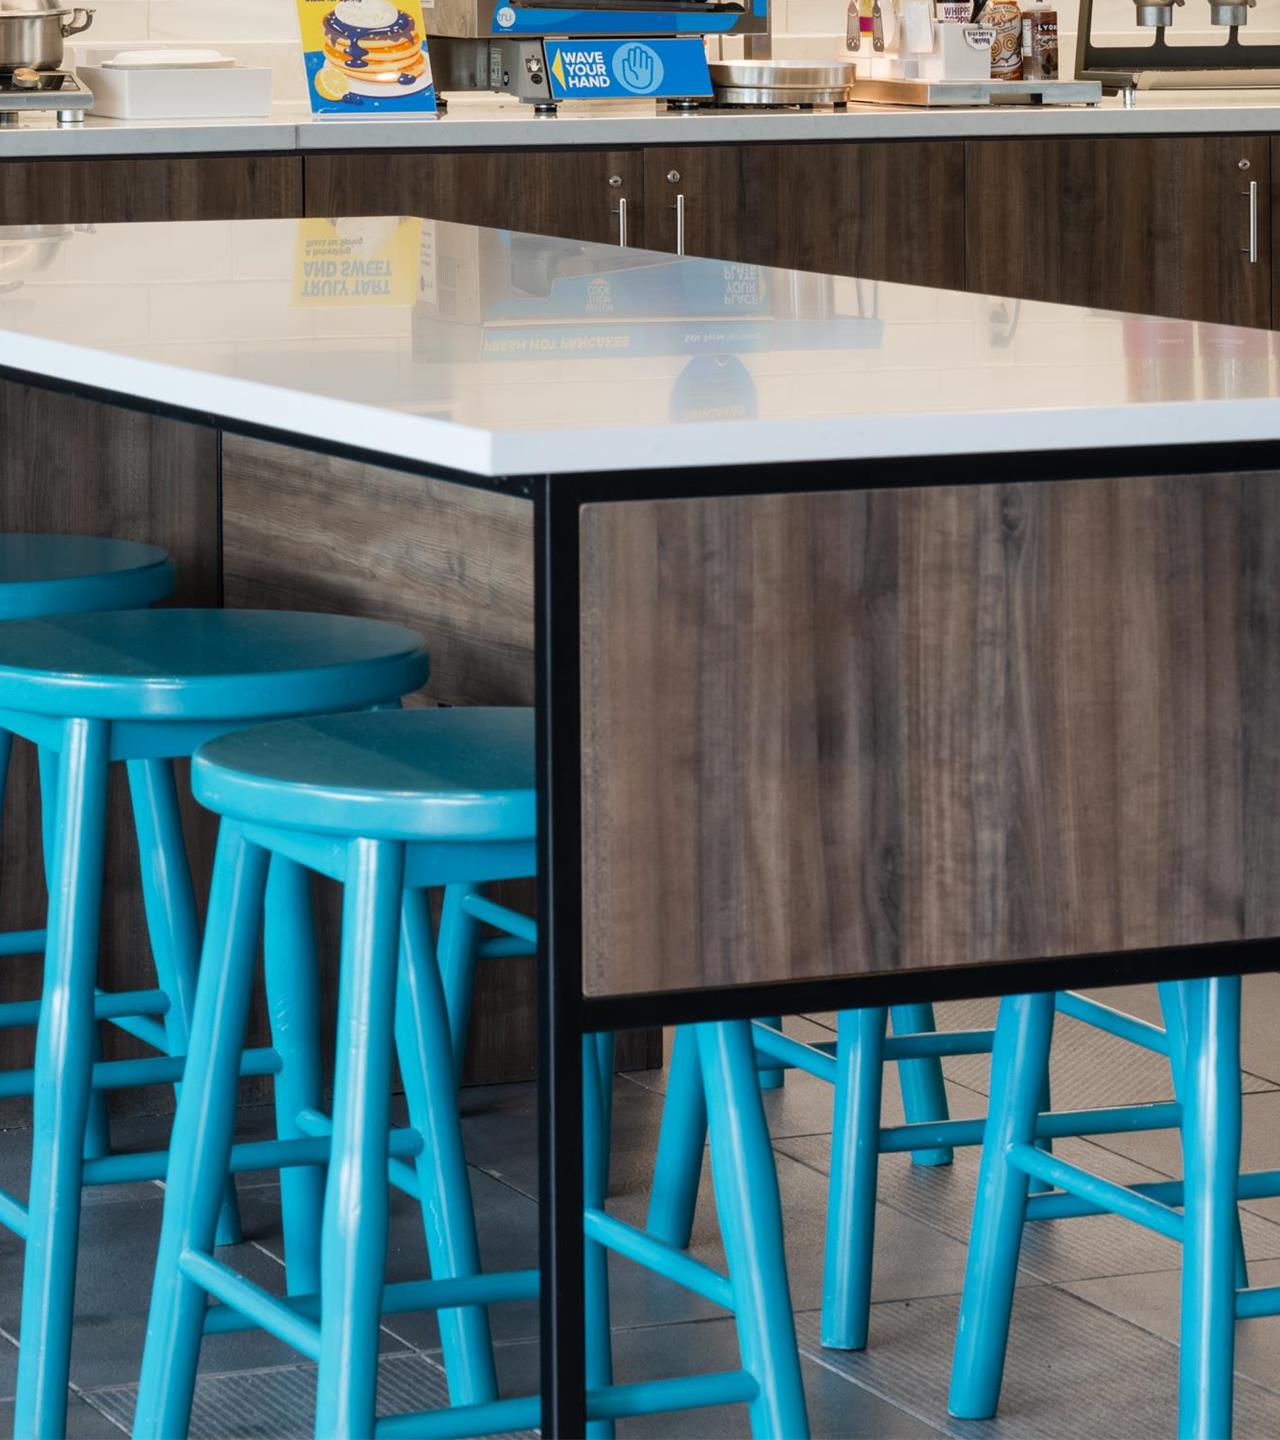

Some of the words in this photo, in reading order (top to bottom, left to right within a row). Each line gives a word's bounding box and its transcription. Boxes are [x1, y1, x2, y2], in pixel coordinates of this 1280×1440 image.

[562, 51, 604, 64] WAVE
[565, 64, 607, 76] YOUR
[569, 76, 611, 89] HAND
